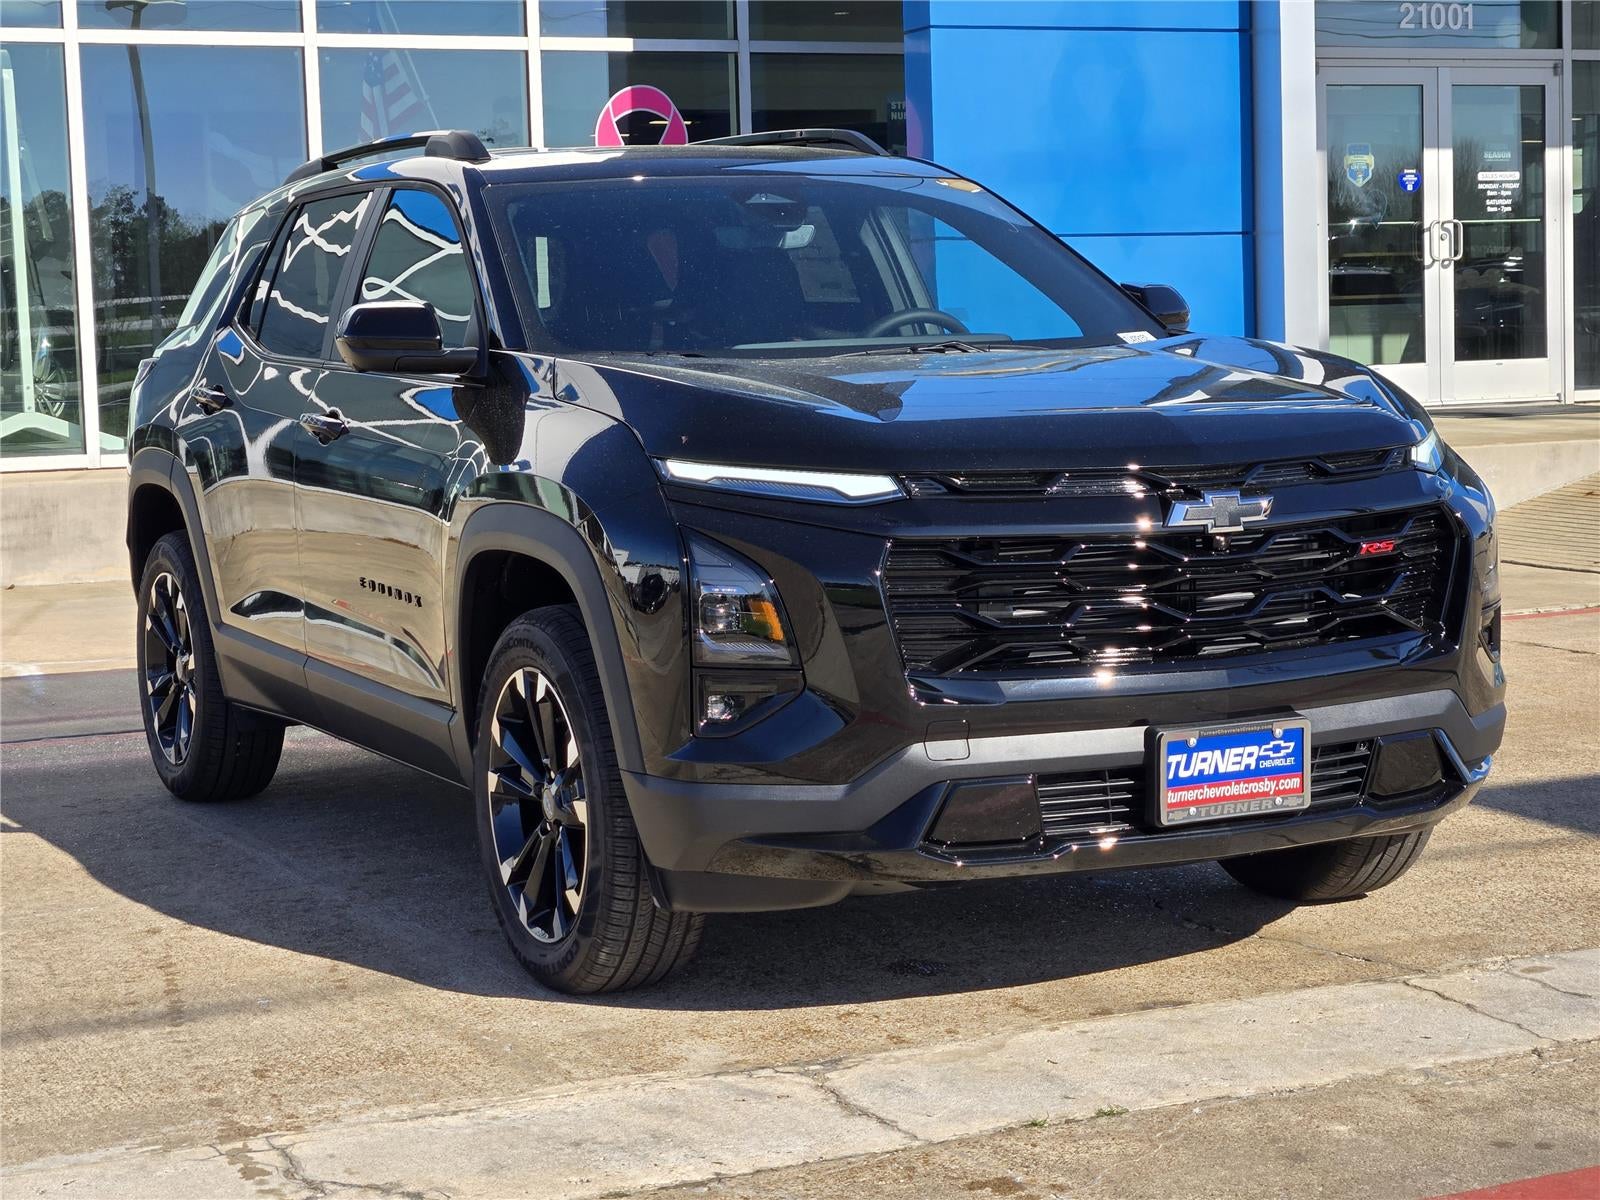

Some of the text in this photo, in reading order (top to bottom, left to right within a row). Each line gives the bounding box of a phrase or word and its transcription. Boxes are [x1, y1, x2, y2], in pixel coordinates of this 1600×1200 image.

[1400, 3, 1473, 30] 21001
[1360, 540, 1394, 554] RS
[359, 576, 422, 607] EQUINOX
[1168, 745, 1260, 779] TURNER
[1259, 757, 1295, 768] CHEVROLET
[1167, 776, 1300, 803] turnerchevroletcrosby.com
[1199, 799, 1273, 817] TURNER
